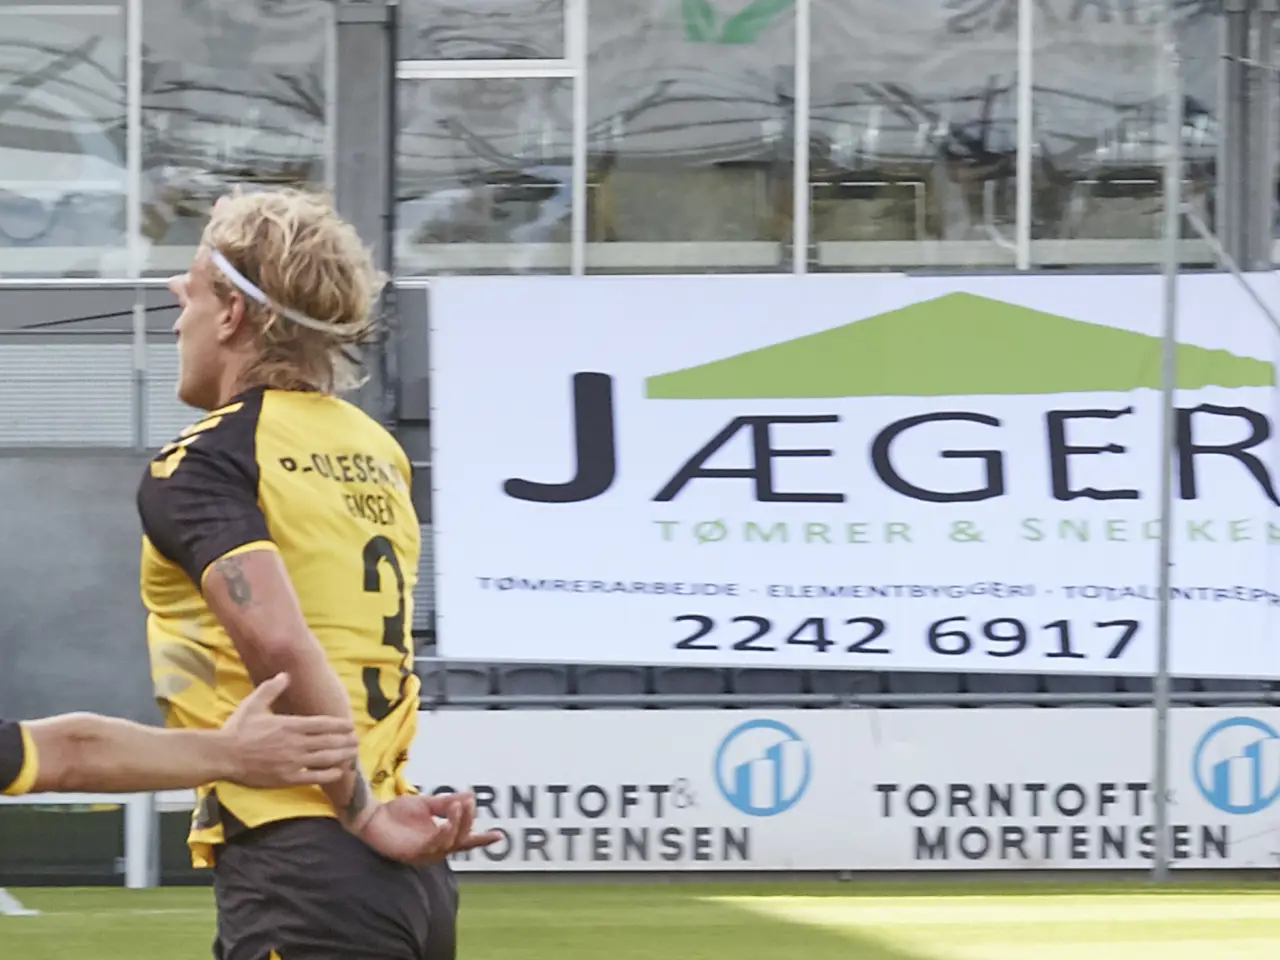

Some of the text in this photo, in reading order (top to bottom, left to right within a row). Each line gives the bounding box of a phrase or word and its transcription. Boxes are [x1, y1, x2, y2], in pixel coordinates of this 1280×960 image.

[503, 371, 1280, 506] JÆGER
[653, 519, 913, 545] TØMRER
[948, 519, 984, 543] &
[476, 575, 1280, 606] TØMRERARBEJDE ELEMENTBYGGERI TOTALNTREP
[363, 535, 409, 722] 3
[672, 613, 1140, 660] 2242 6917
[415, 784, 671, 819] RNTOFT
[874, 783, 1150, 818] TORNTOFT
[912, 825, 1231, 860] MORTENSEN
